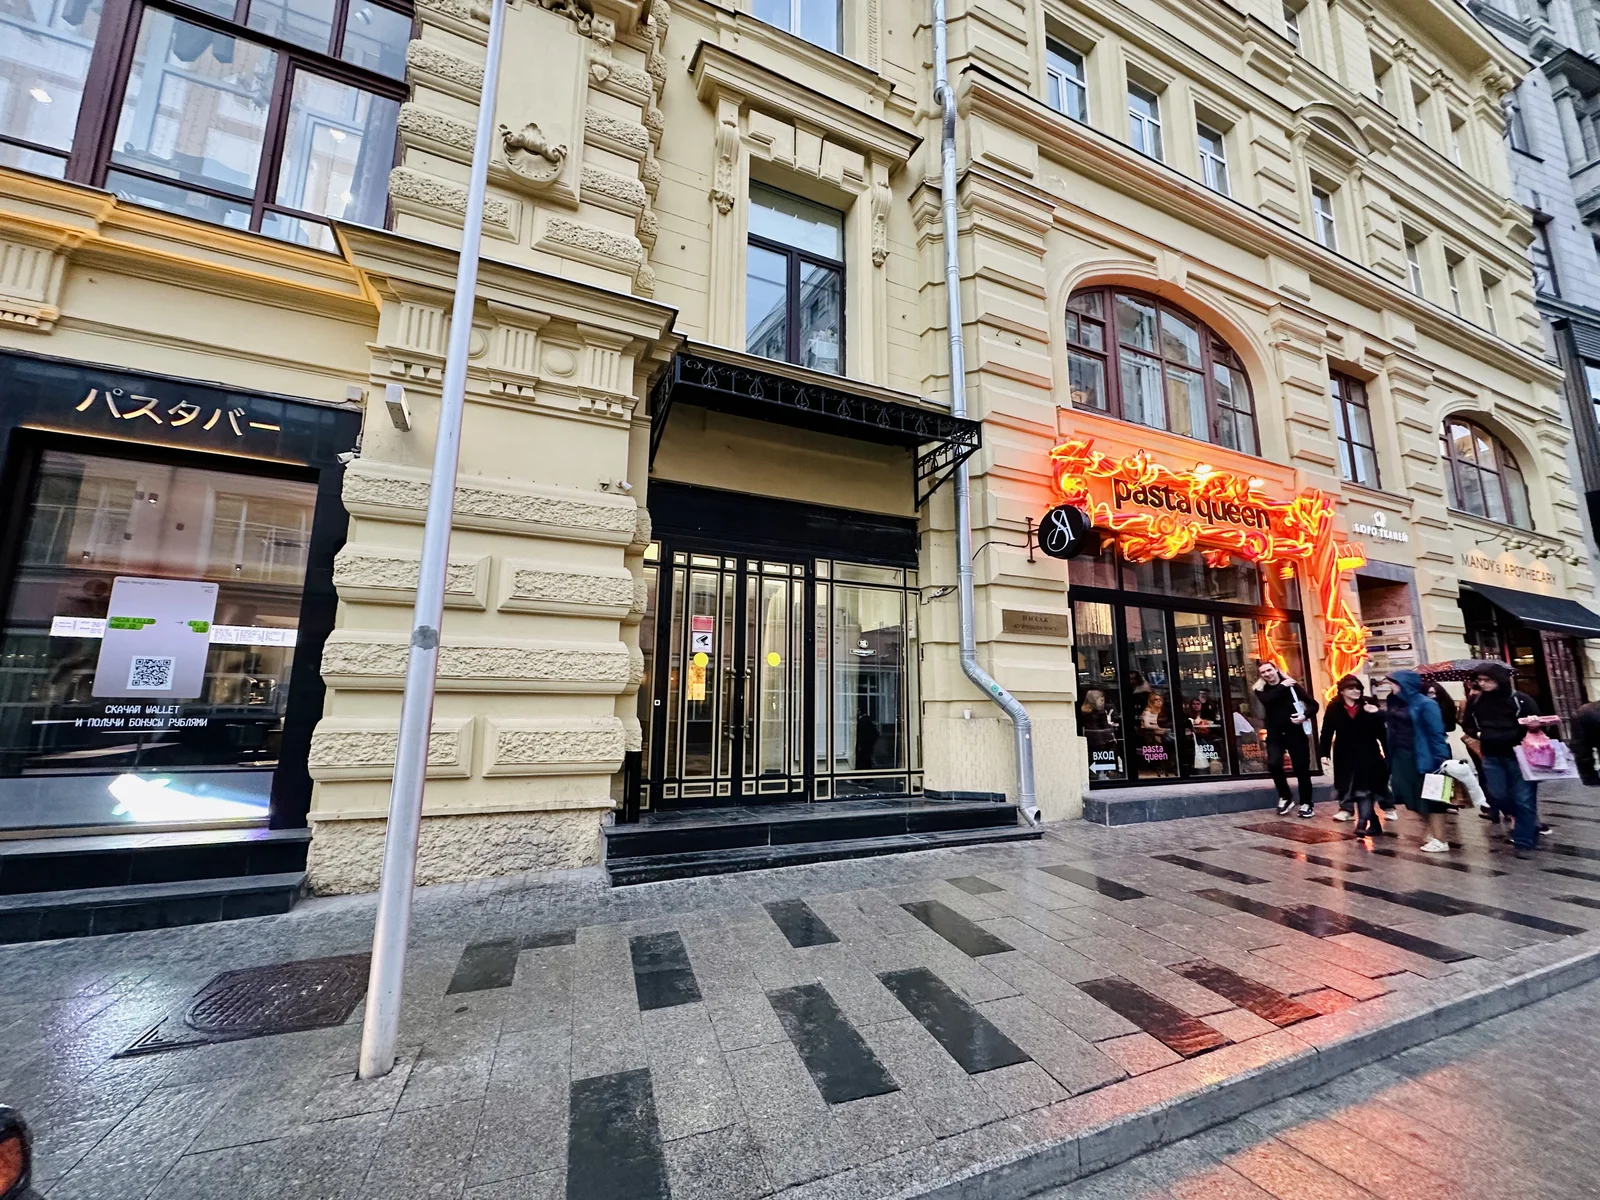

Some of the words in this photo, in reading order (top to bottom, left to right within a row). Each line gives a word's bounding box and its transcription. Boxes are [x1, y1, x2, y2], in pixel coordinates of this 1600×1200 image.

[75, 388, 280, 436] パスタバー
[1112, 477, 1192, 514] pasta
[1195, 495, 1271, 530] queen
[1503, 563, 1556, 585] APOTHECARY
[105, 705, 141, 714] СКАЧАЙ
[145, 705, 180, 714] WALLET
[75, 718, 82, 727] И
[87, 718, 124, 727] ПОЛУЧИ
[128, 718, 164, 727] БОНУСЫ
[168, 718, 208, 727] РУБЛЯМИ
[1142, 744, 1164, 755] pasta
[1092, 751, 1115, 761] ВХОД
[1144, 751, 1168, 763] queen
